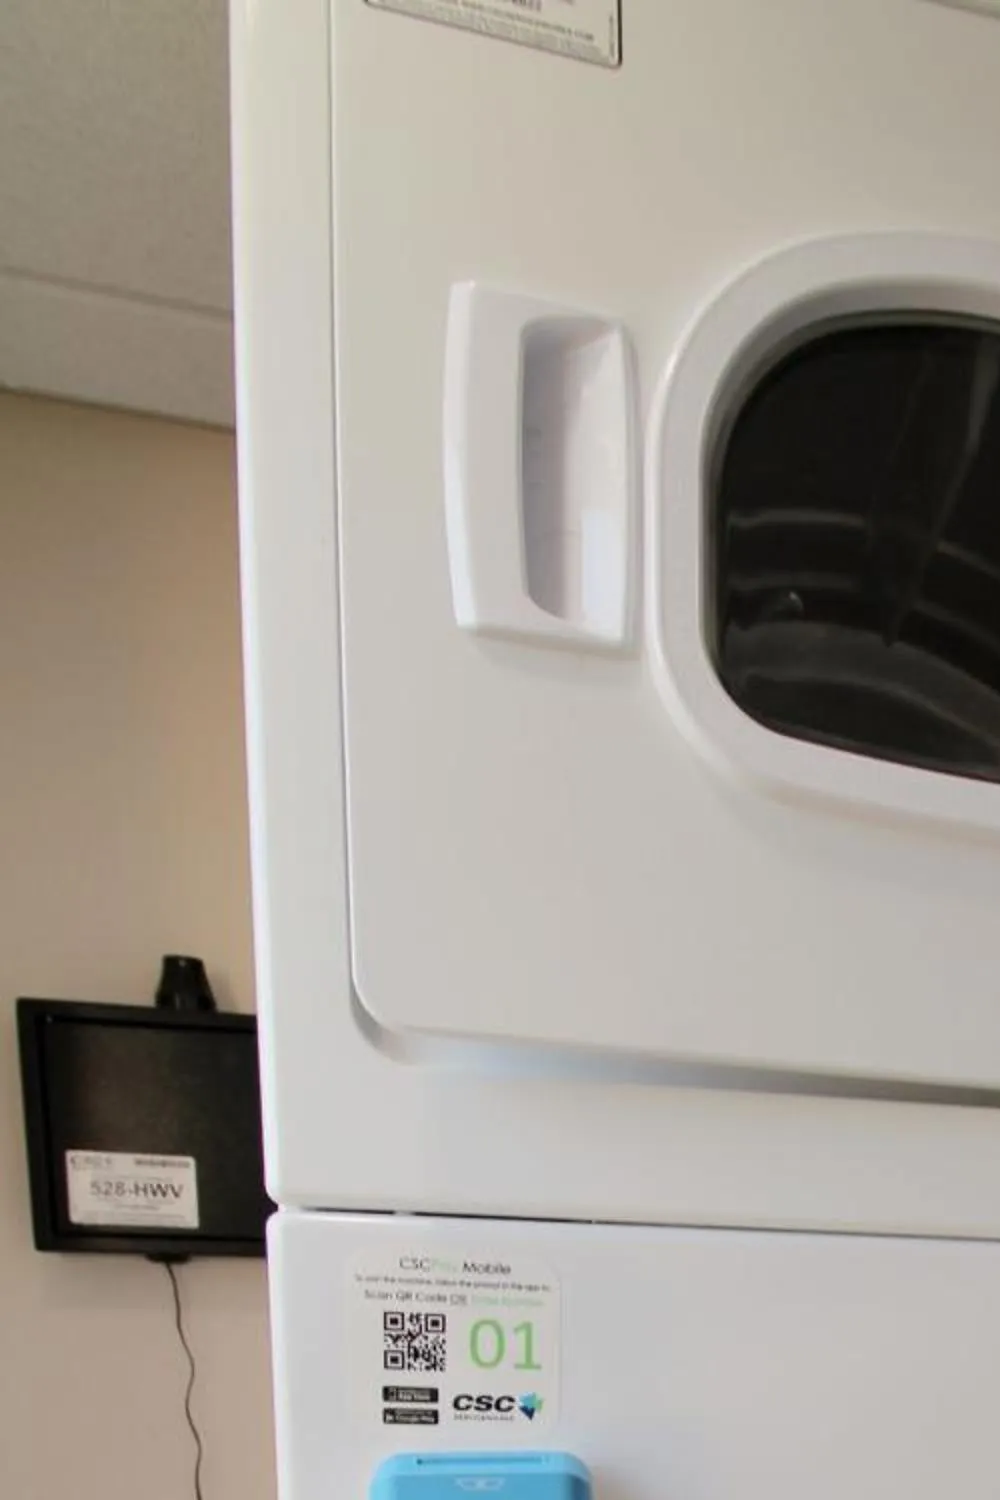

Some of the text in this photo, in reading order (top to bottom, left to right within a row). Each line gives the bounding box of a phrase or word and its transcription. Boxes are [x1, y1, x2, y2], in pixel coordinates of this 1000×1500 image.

[90, 1181, 183, 1199] 528-HWV
[462, 1261, 511, 1276] Mobile
[469, 1318, 542, 1371] 01
[452, 1393, 516, 1413] CSC
